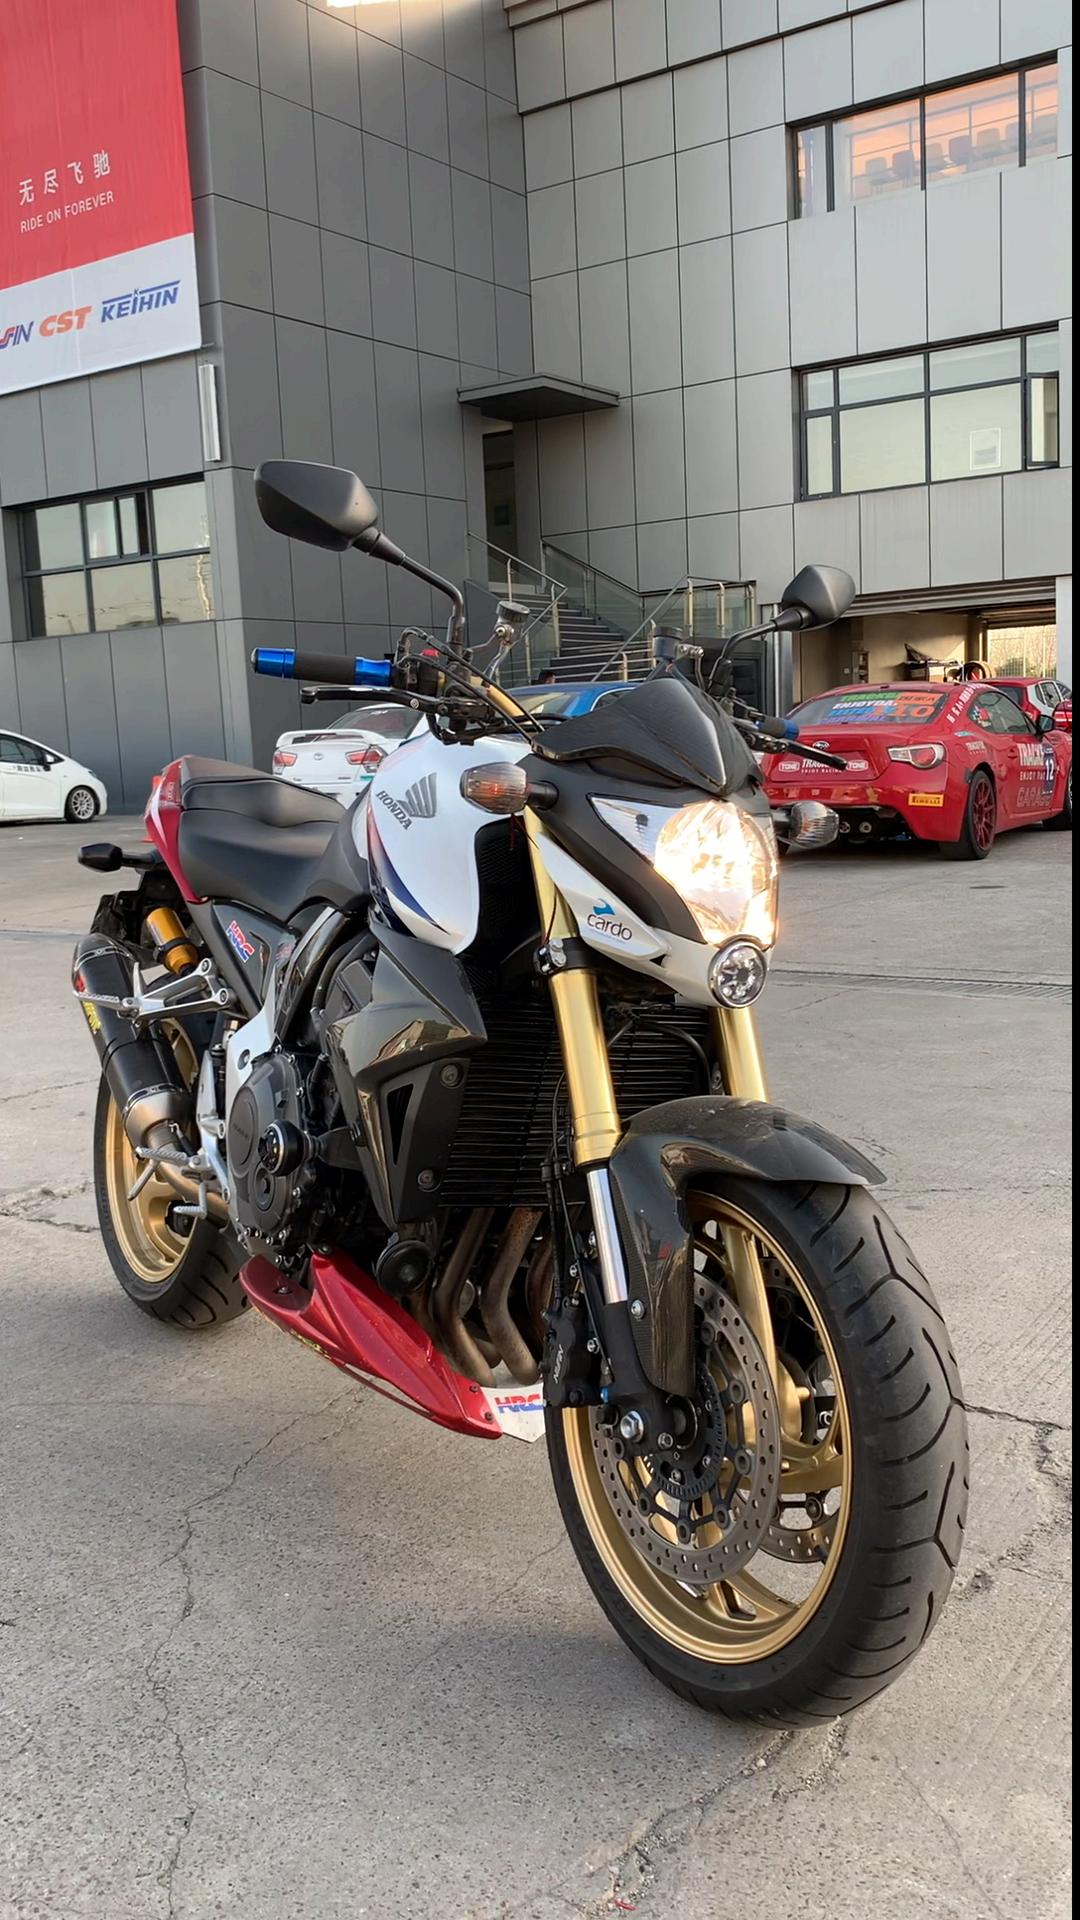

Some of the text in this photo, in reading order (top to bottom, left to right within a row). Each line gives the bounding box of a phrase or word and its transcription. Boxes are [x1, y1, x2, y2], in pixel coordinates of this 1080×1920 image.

[19, 150, 111, 205] 无尽飞驰
[20, 191, 115, 233] RIDE ON FOREVER
[40, 305, 93, 337] CST
[101, 281, 181, 323] KEIHIN
[1045, 758, 1054, 780] 12
[375, 790, 412, 831] HONDA
[226, 920, 255, 963] HRC
[587, 913, 633, 941] cardo
[494, 1393, 545, 1414] HRC
